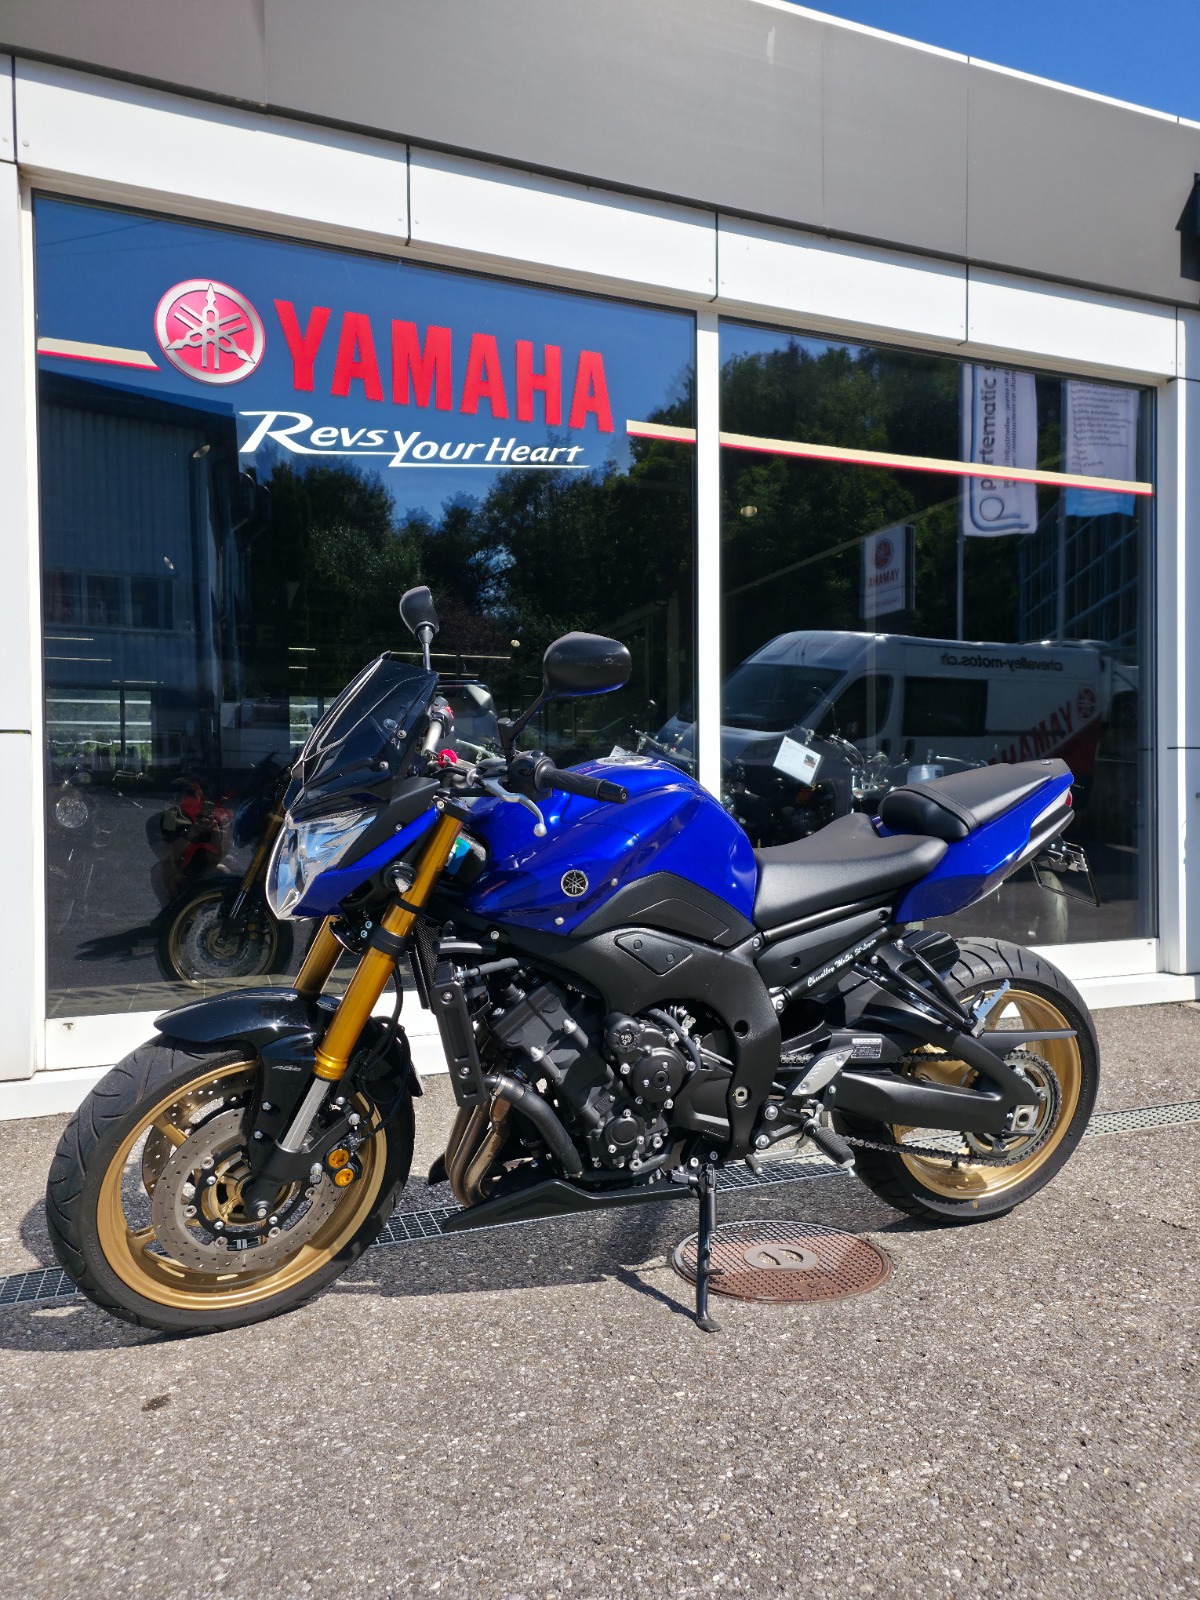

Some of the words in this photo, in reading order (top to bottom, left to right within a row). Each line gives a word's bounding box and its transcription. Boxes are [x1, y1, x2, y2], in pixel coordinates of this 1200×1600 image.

[275, 299, 614, 433] YAMAHA
[239, 410, 391, 456] Revs
[388, 430, 486, 468] Your
[484, 438, 585, 464] Heart
[979, 378, 997, 491] prtematic
